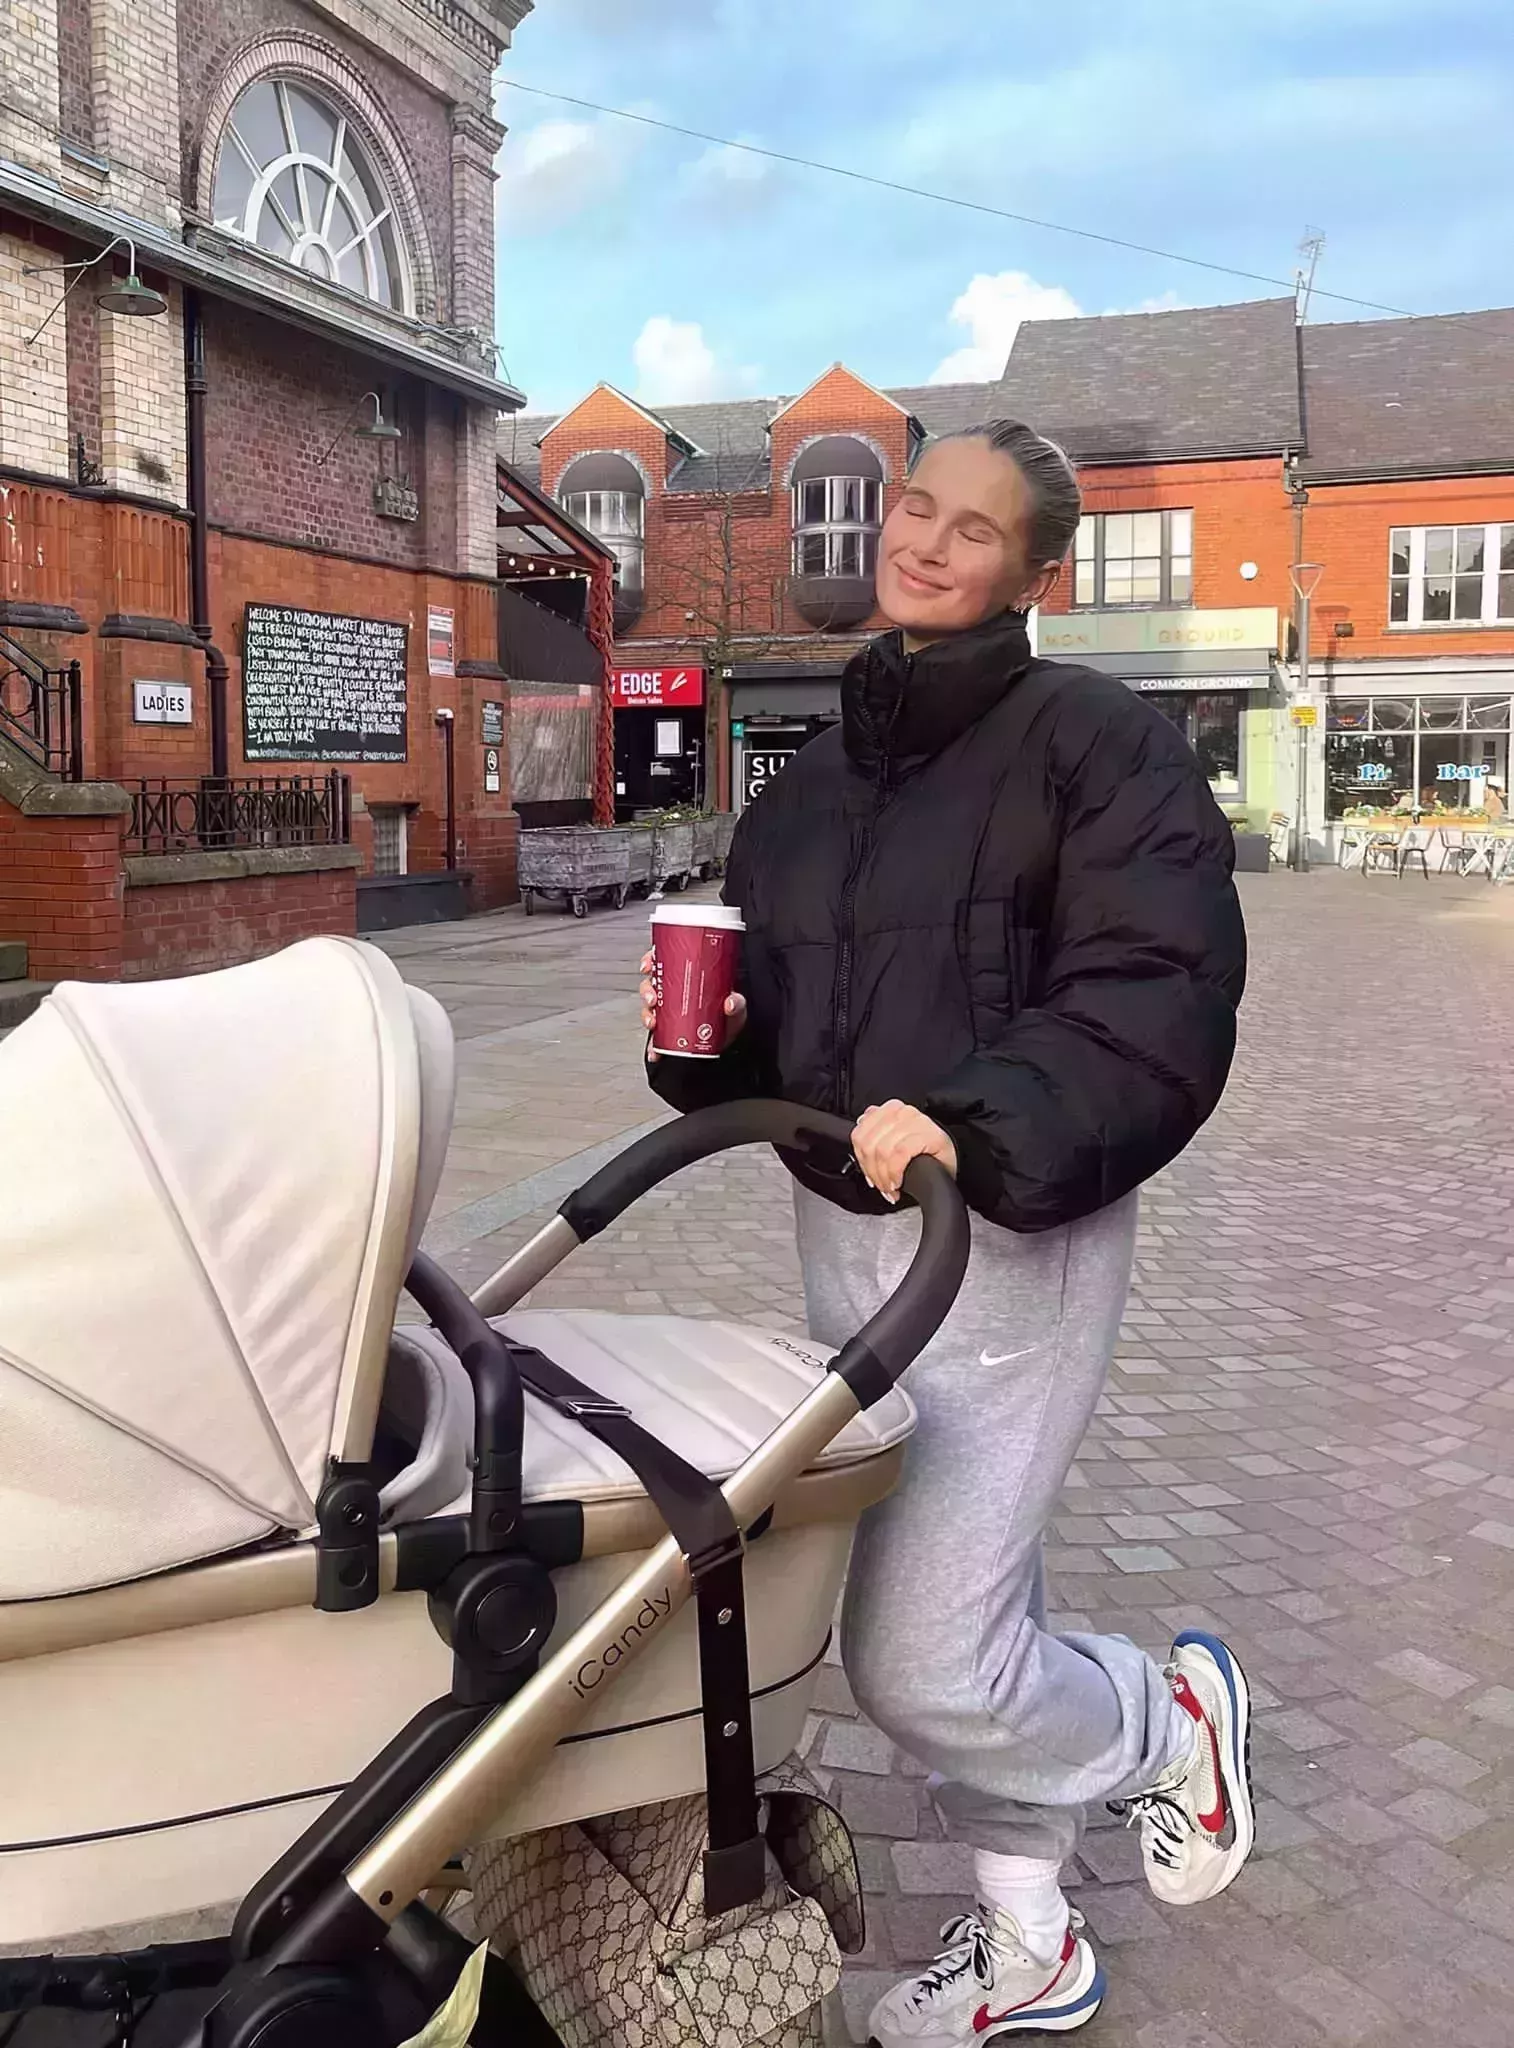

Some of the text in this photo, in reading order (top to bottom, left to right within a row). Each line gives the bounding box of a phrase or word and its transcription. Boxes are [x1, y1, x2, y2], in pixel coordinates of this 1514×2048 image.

[249, 606, 280, 622] WELCOME
[282, 611, 292, 622] TO
[265, 622, 296, 639] FIERCELY
[1158, 627, 1245, 644] GROUND
[247, 632, 272, 647] LISTED
[620, 672, 662, 695] EDGE
[1140, 677, 1253, 690] COMMON GROUND
[142, 695, 184, 712] LADIES
[1357, 763, 1490, 781] Pi Bar
[749, 779, 766, 798] G
[568, 1587, 672, 1699] iCandy
